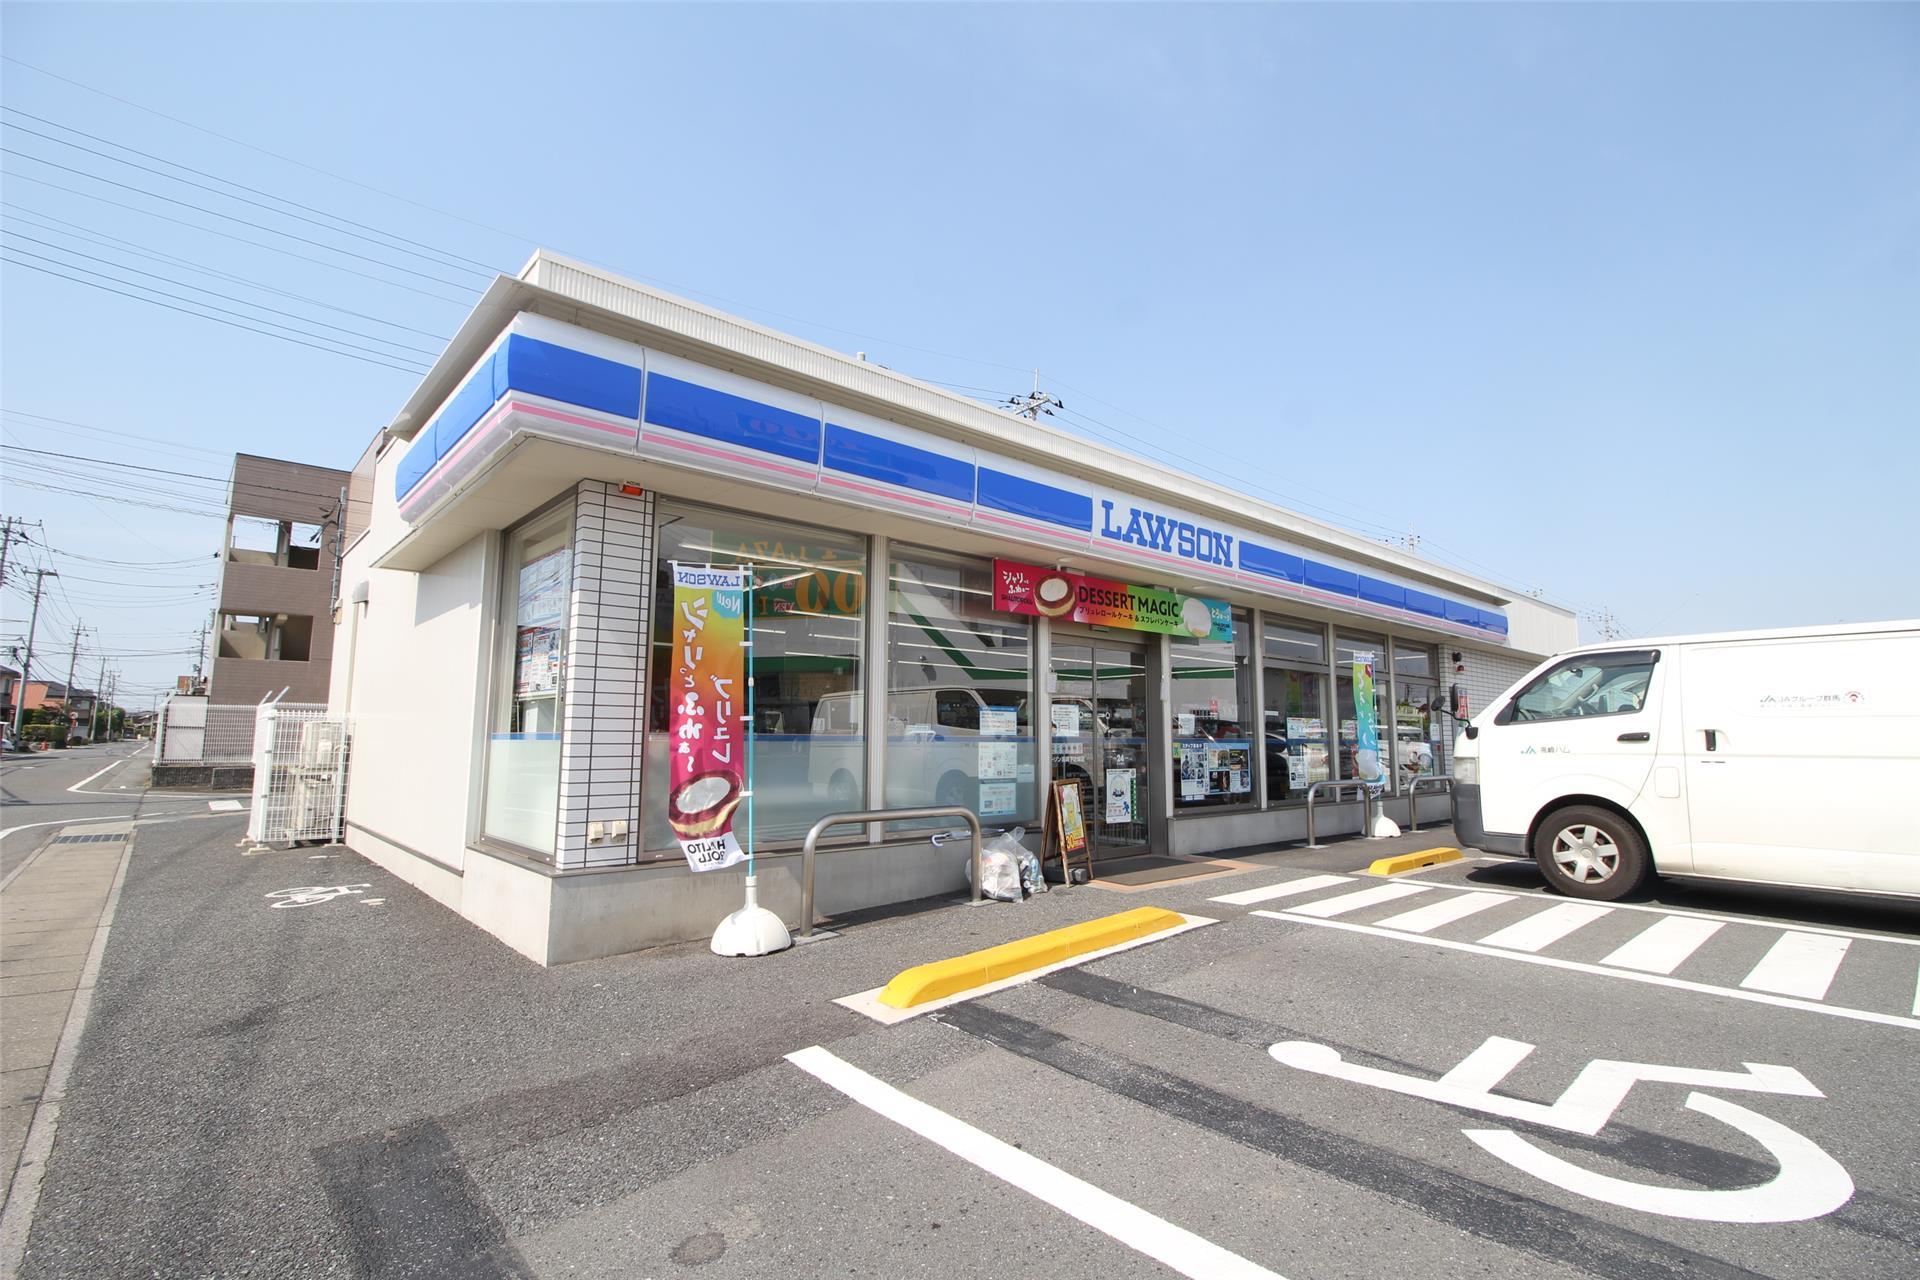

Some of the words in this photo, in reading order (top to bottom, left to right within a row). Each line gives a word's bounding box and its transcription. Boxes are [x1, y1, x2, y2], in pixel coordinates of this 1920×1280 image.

[1101, 499, 1233, 568] LAWSON
[1078, 586, 1135, 611] DESSERT
[1138, 596, 1179, 618] MAGIC
[1079, 606, 1134, 622] ブリュレロールケーキ
[1116, 754, 1125, 762] 24
